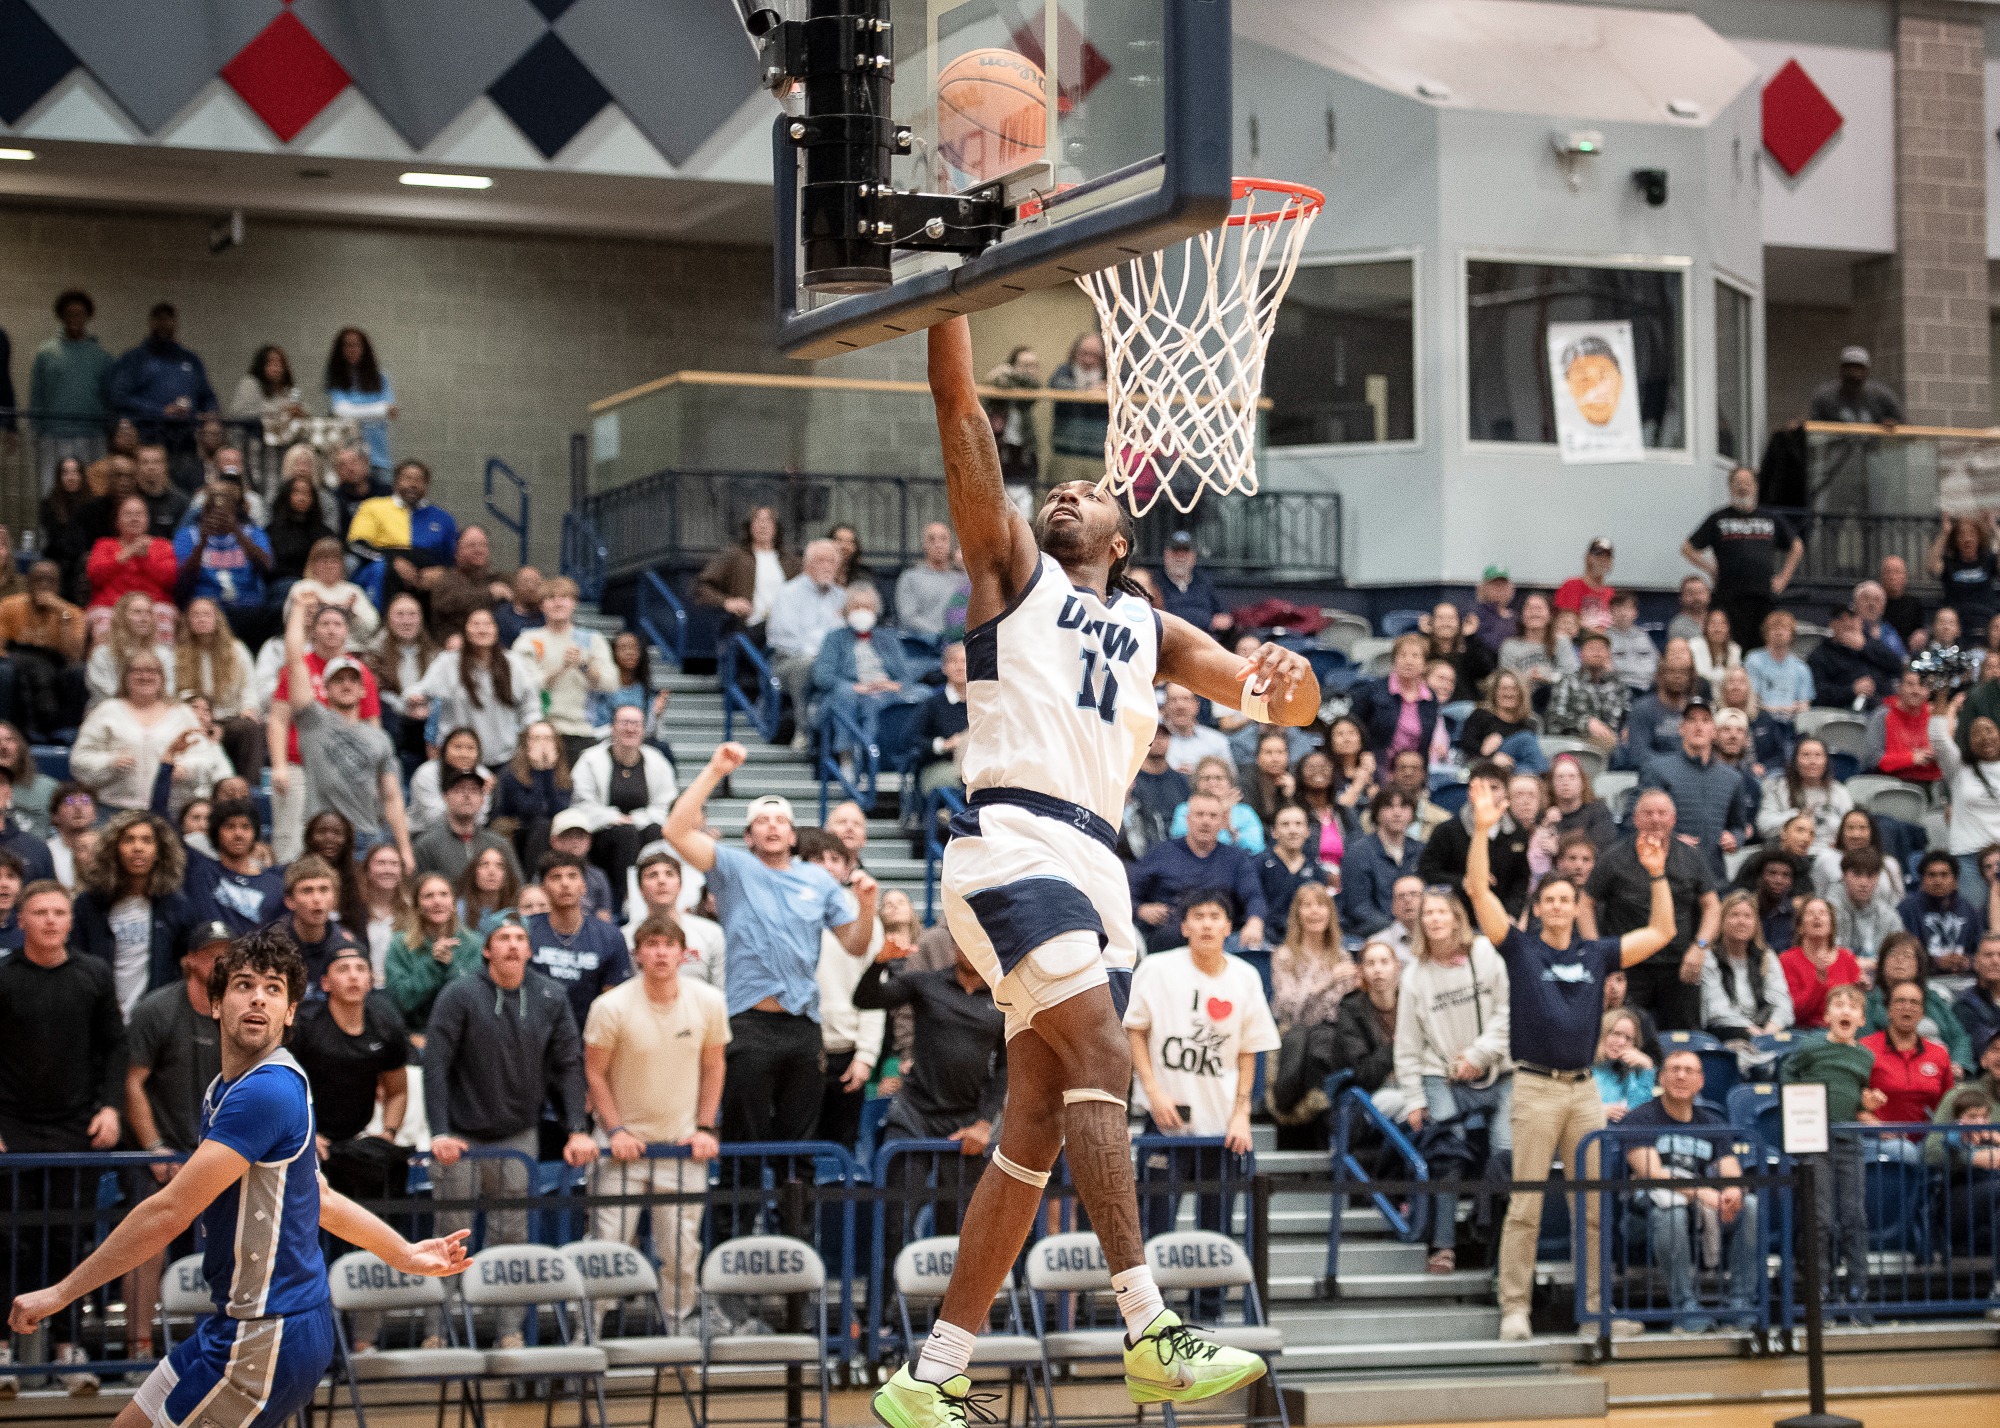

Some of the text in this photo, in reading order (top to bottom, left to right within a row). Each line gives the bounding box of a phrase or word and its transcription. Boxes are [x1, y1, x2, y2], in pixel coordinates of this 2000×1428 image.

[1076, 646, 1119, 726] 11
[1192, 989, 1200, 1012] I
[568, 1252, 639, 1279] AGLES
[721, 1249, 804, 1275] EAGLES
[1044, 1246, 1108, 1272] EAGLE
[1155, 1243, 1234, 1268] EAGLES
[481, 1258, 565, 1285] EAGLES
